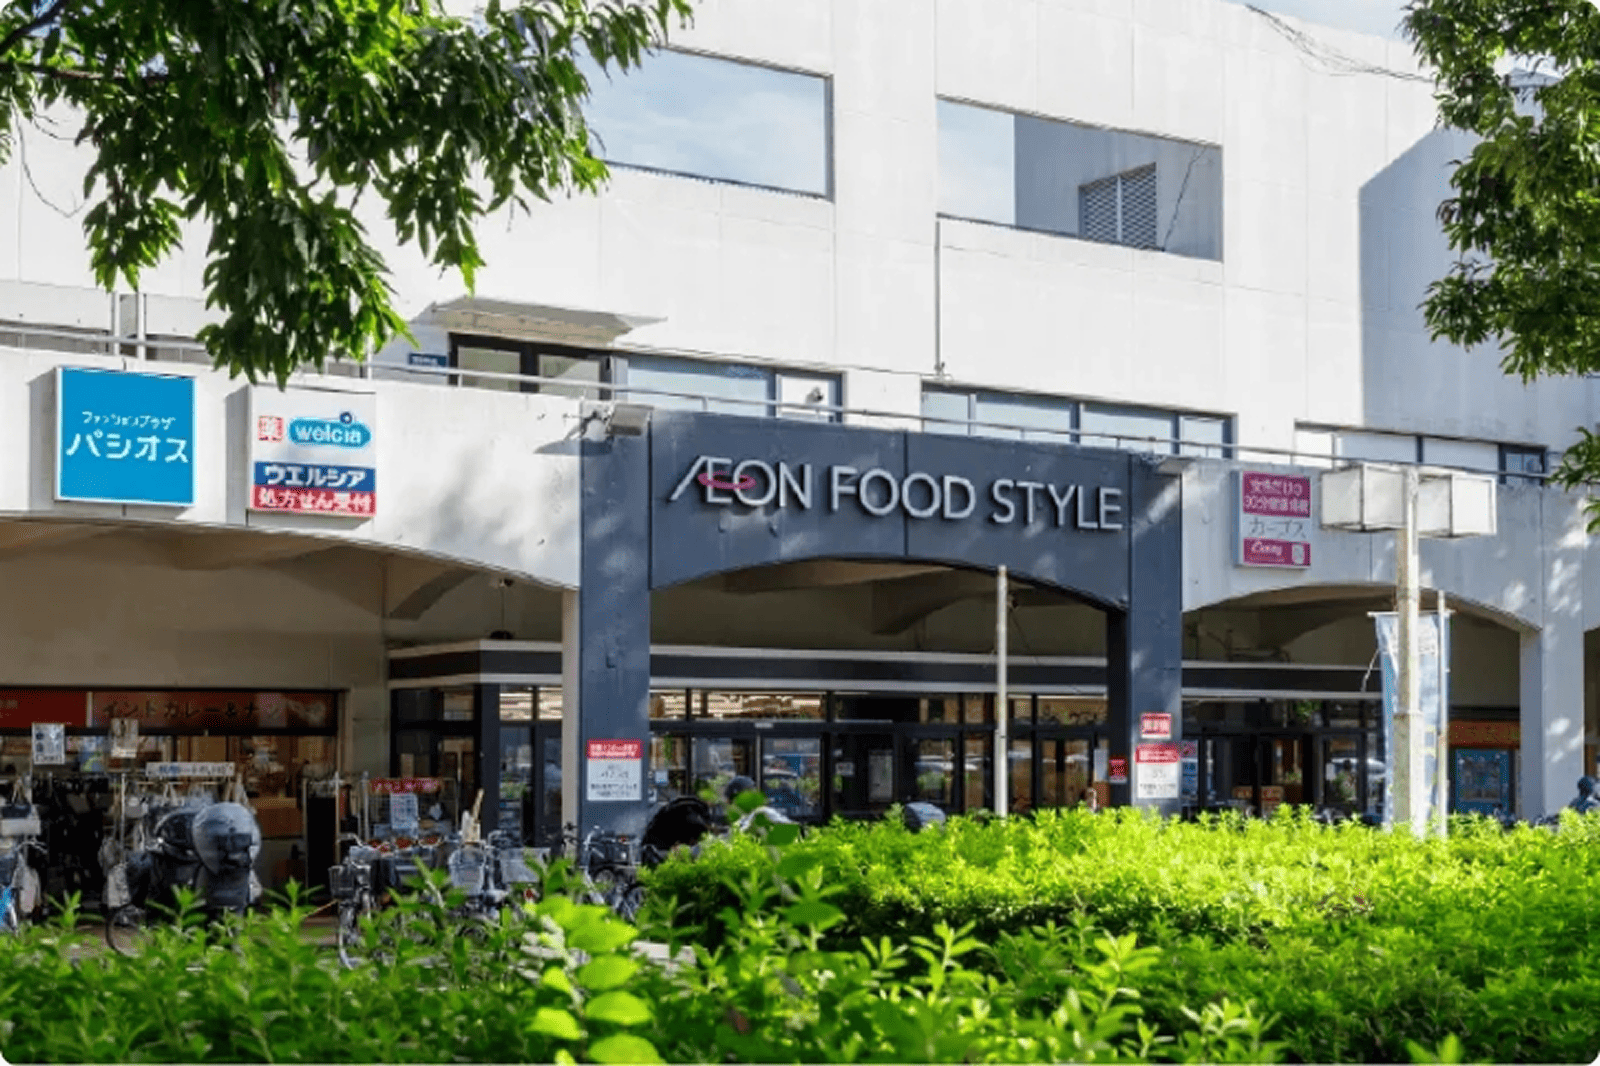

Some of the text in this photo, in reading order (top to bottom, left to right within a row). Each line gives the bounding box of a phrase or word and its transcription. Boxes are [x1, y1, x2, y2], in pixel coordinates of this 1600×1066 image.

[294, 413, 362, 445] welcia
[66, 429, 189, 463] パシオス
[264, 464, 367, 488] ウエルシア
[831, 465, 977, 520] FOOD
[992, 478, 1124, 530] STYLE
